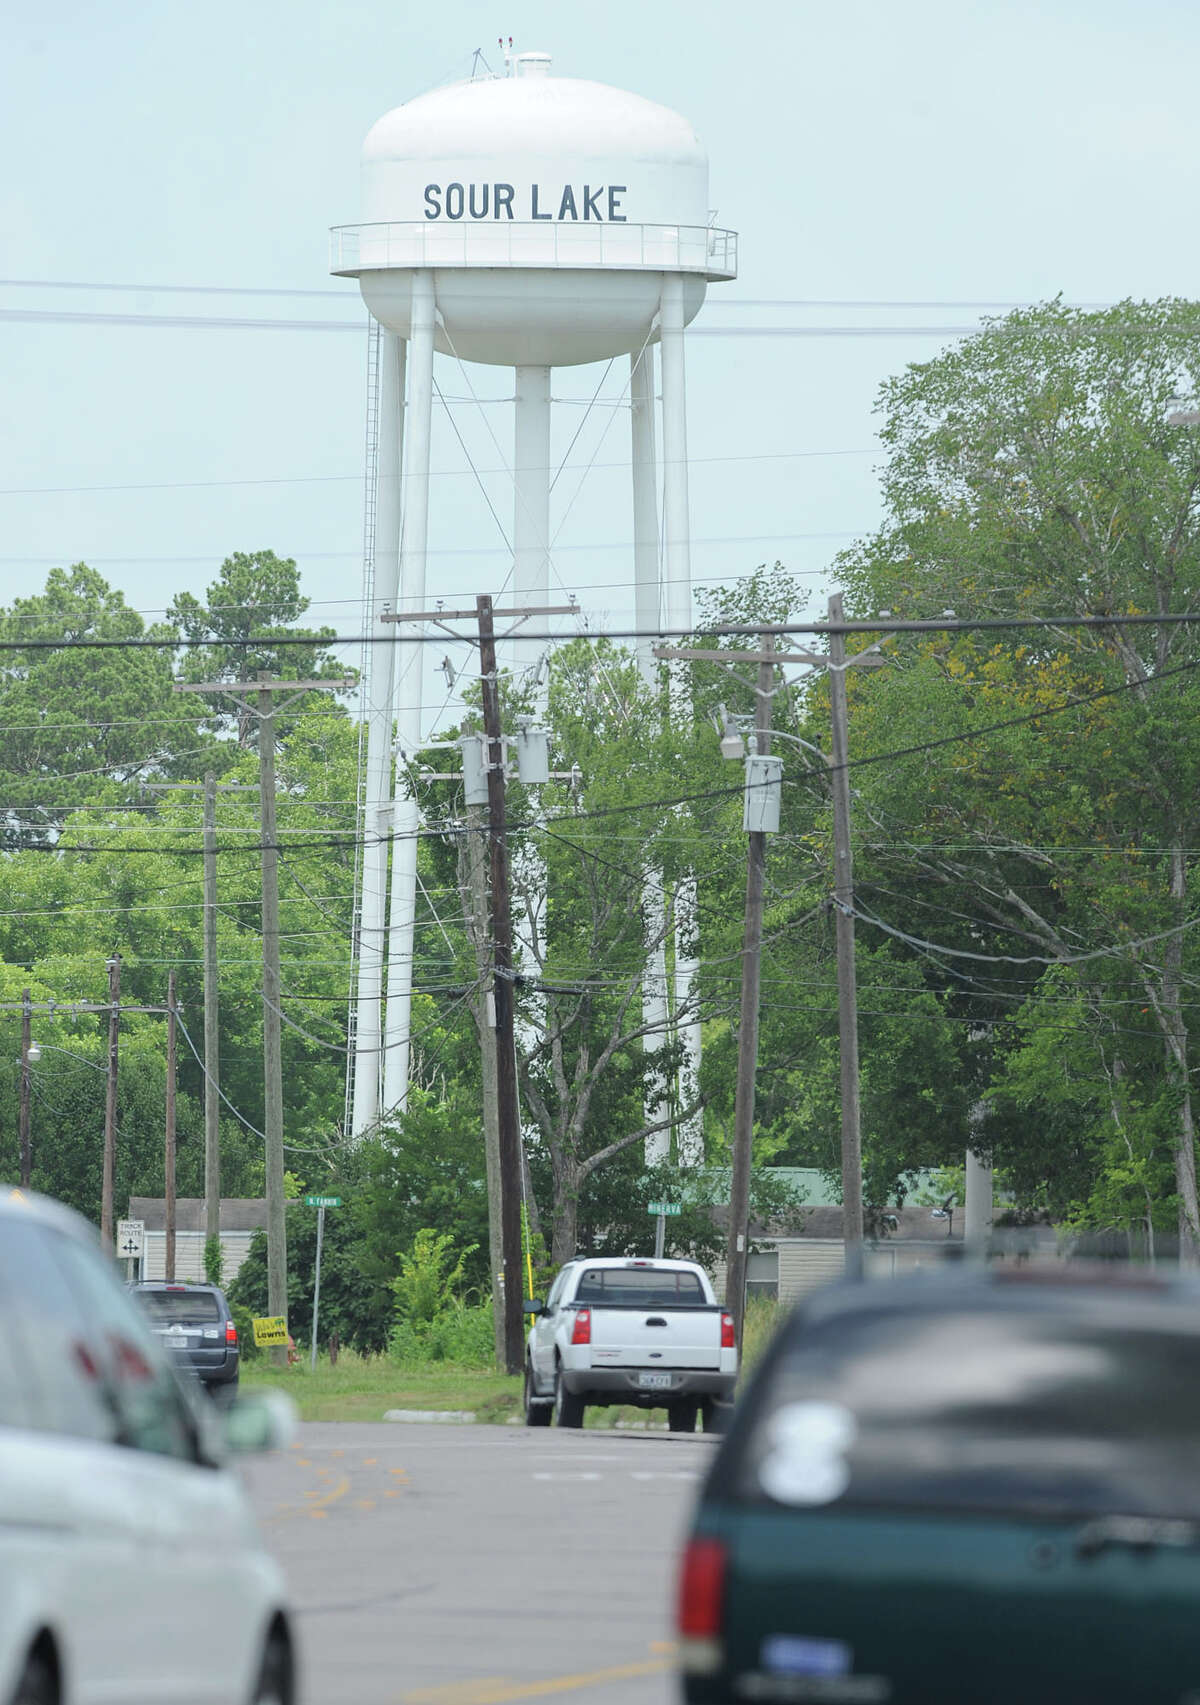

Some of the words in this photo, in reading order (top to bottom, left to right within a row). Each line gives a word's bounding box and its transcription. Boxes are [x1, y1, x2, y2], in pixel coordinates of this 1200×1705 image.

[424, 183, 514, 220] SOUR
[531, 184, 627, 222] LAKE
[648, 1203, 680, 1213] MINERVA
[257, 1330, 285, 1338] Lawns
